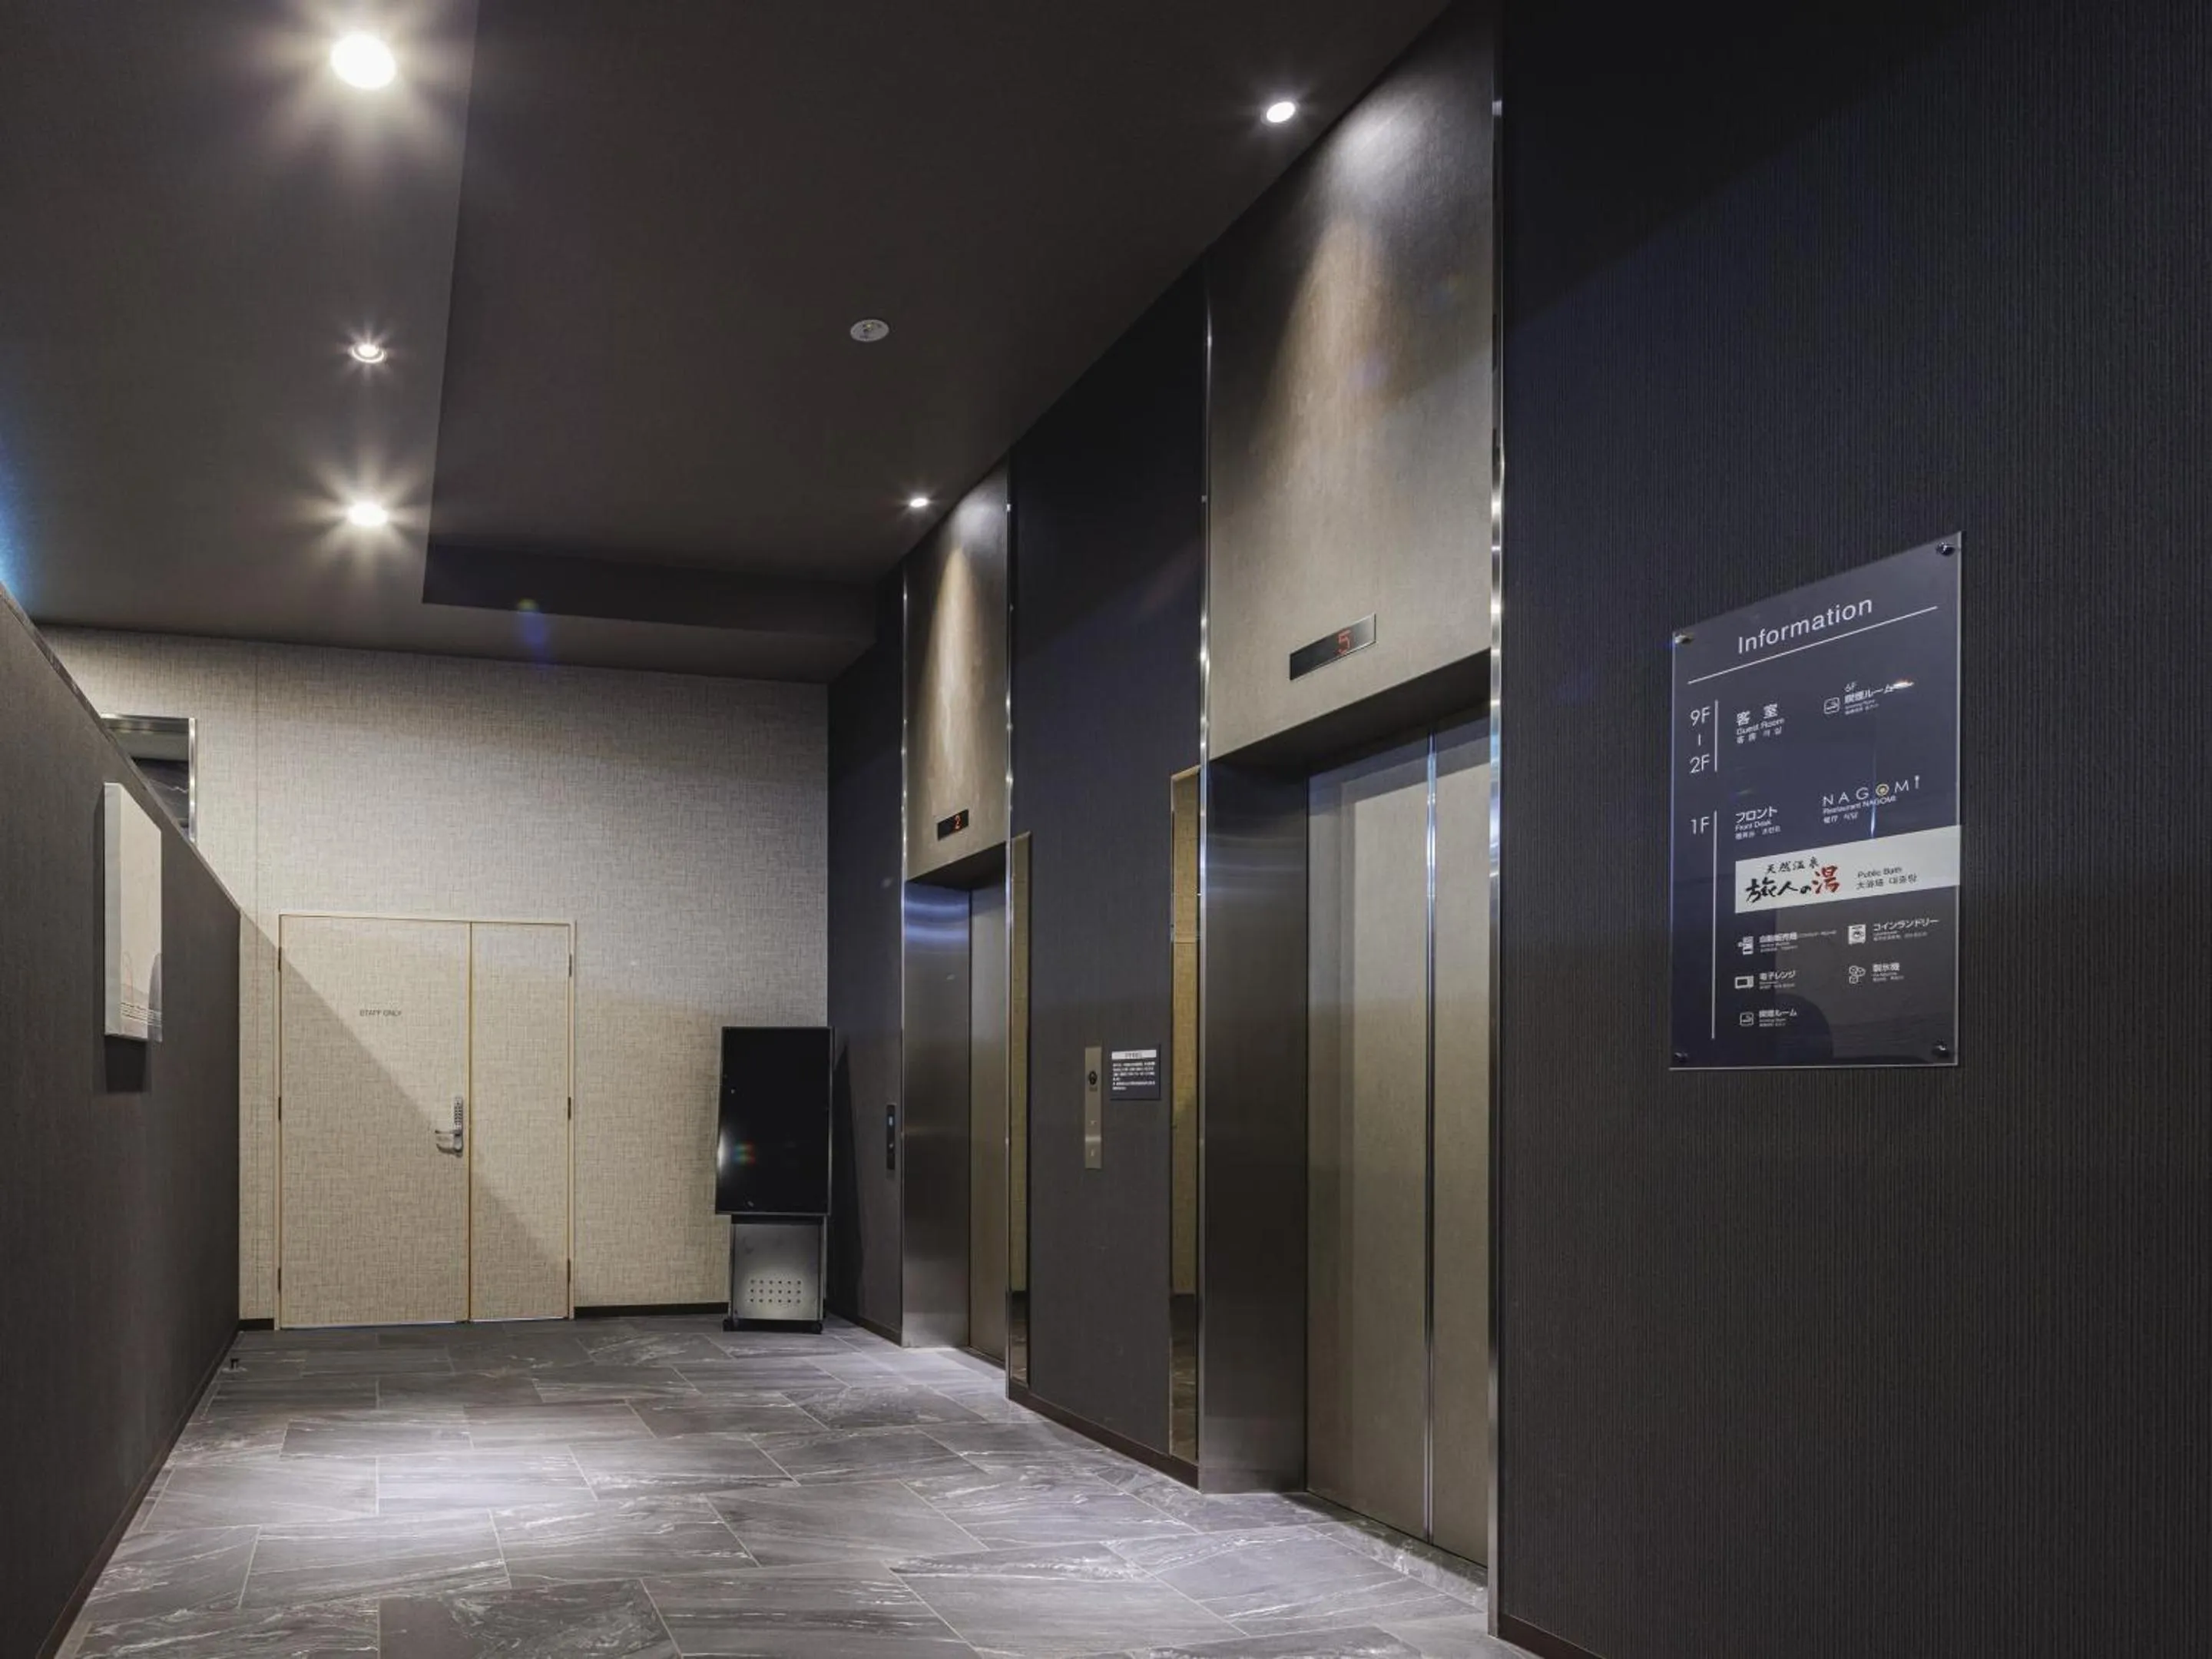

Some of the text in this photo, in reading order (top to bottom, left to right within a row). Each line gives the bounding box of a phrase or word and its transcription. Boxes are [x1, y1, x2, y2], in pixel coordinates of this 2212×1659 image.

[1737, 599, 1873, 654] Information
[1338, 629, 1351, 654] 5
[1690, 707, 1710, 727] 9F
[1760, 718, 1785, 729] Room
[1690, 753, 1710, 773] 2F
[1823, 775, 1919, 806] NAGOMI
[1736, 806, 1778, 823] フロント
[1690, 816, 1710, 834] 1F
[1767, 856, 1819, 873] 天然温泉
[1858, 866, 1902, 878] Public Bath
[1746, 866, 1839, 902] 旅人の湯
[1874, 917, 1939, 931] コインランドリー
[359, 1008, 402, 1017] STAFF ONLY
